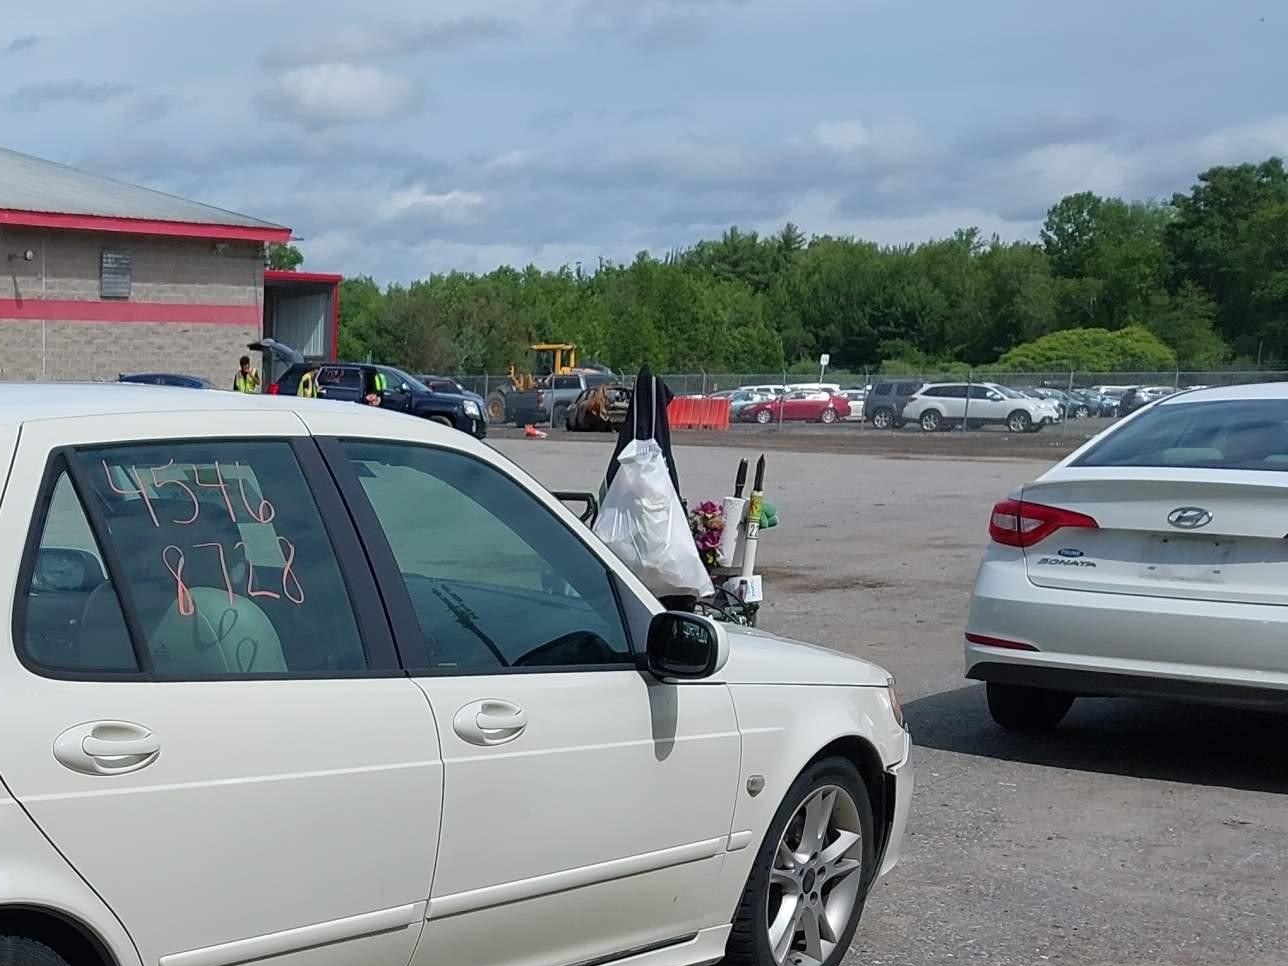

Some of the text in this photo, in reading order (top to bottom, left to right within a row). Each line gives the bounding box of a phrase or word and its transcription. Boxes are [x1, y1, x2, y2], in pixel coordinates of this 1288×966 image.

[102, 458, 276, 528] 4546
[162, 536, 305, 616] 8728
[1037, 558, 1097, 568] SONATA
